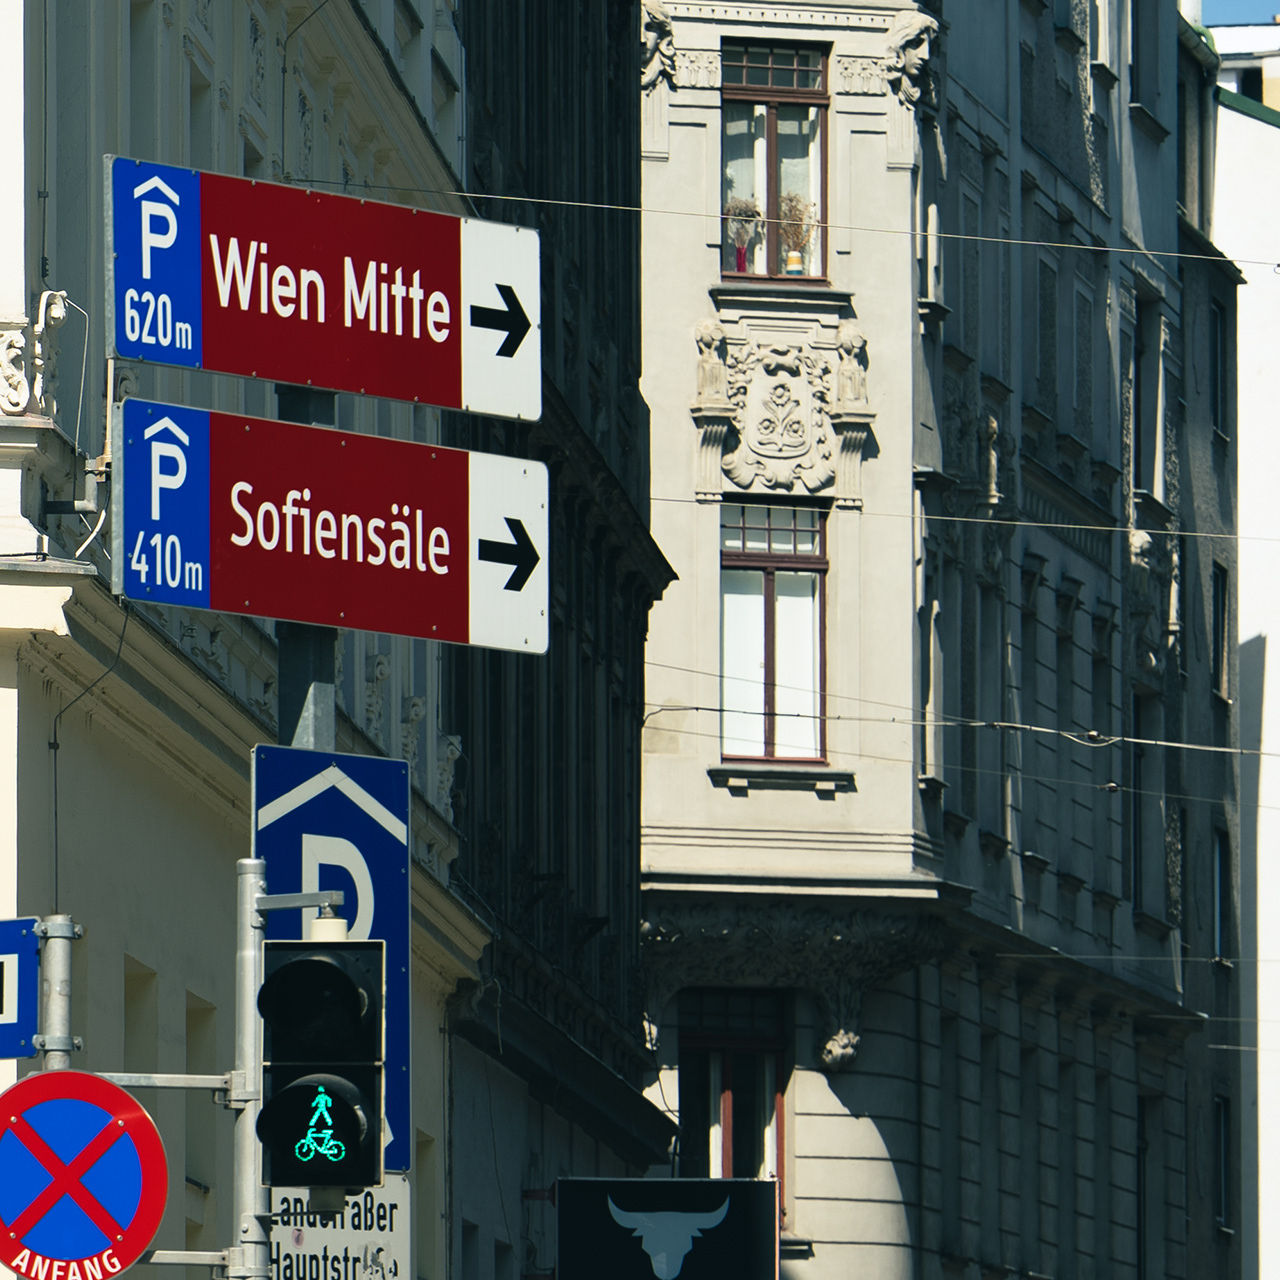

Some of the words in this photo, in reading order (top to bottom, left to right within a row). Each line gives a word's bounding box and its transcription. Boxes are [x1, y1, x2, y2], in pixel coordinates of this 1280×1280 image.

[209, 233, 326, 323] Wien
[343, 255, 451, 343] Mitte
[229, 480, 451, 575] Sofiensäle
